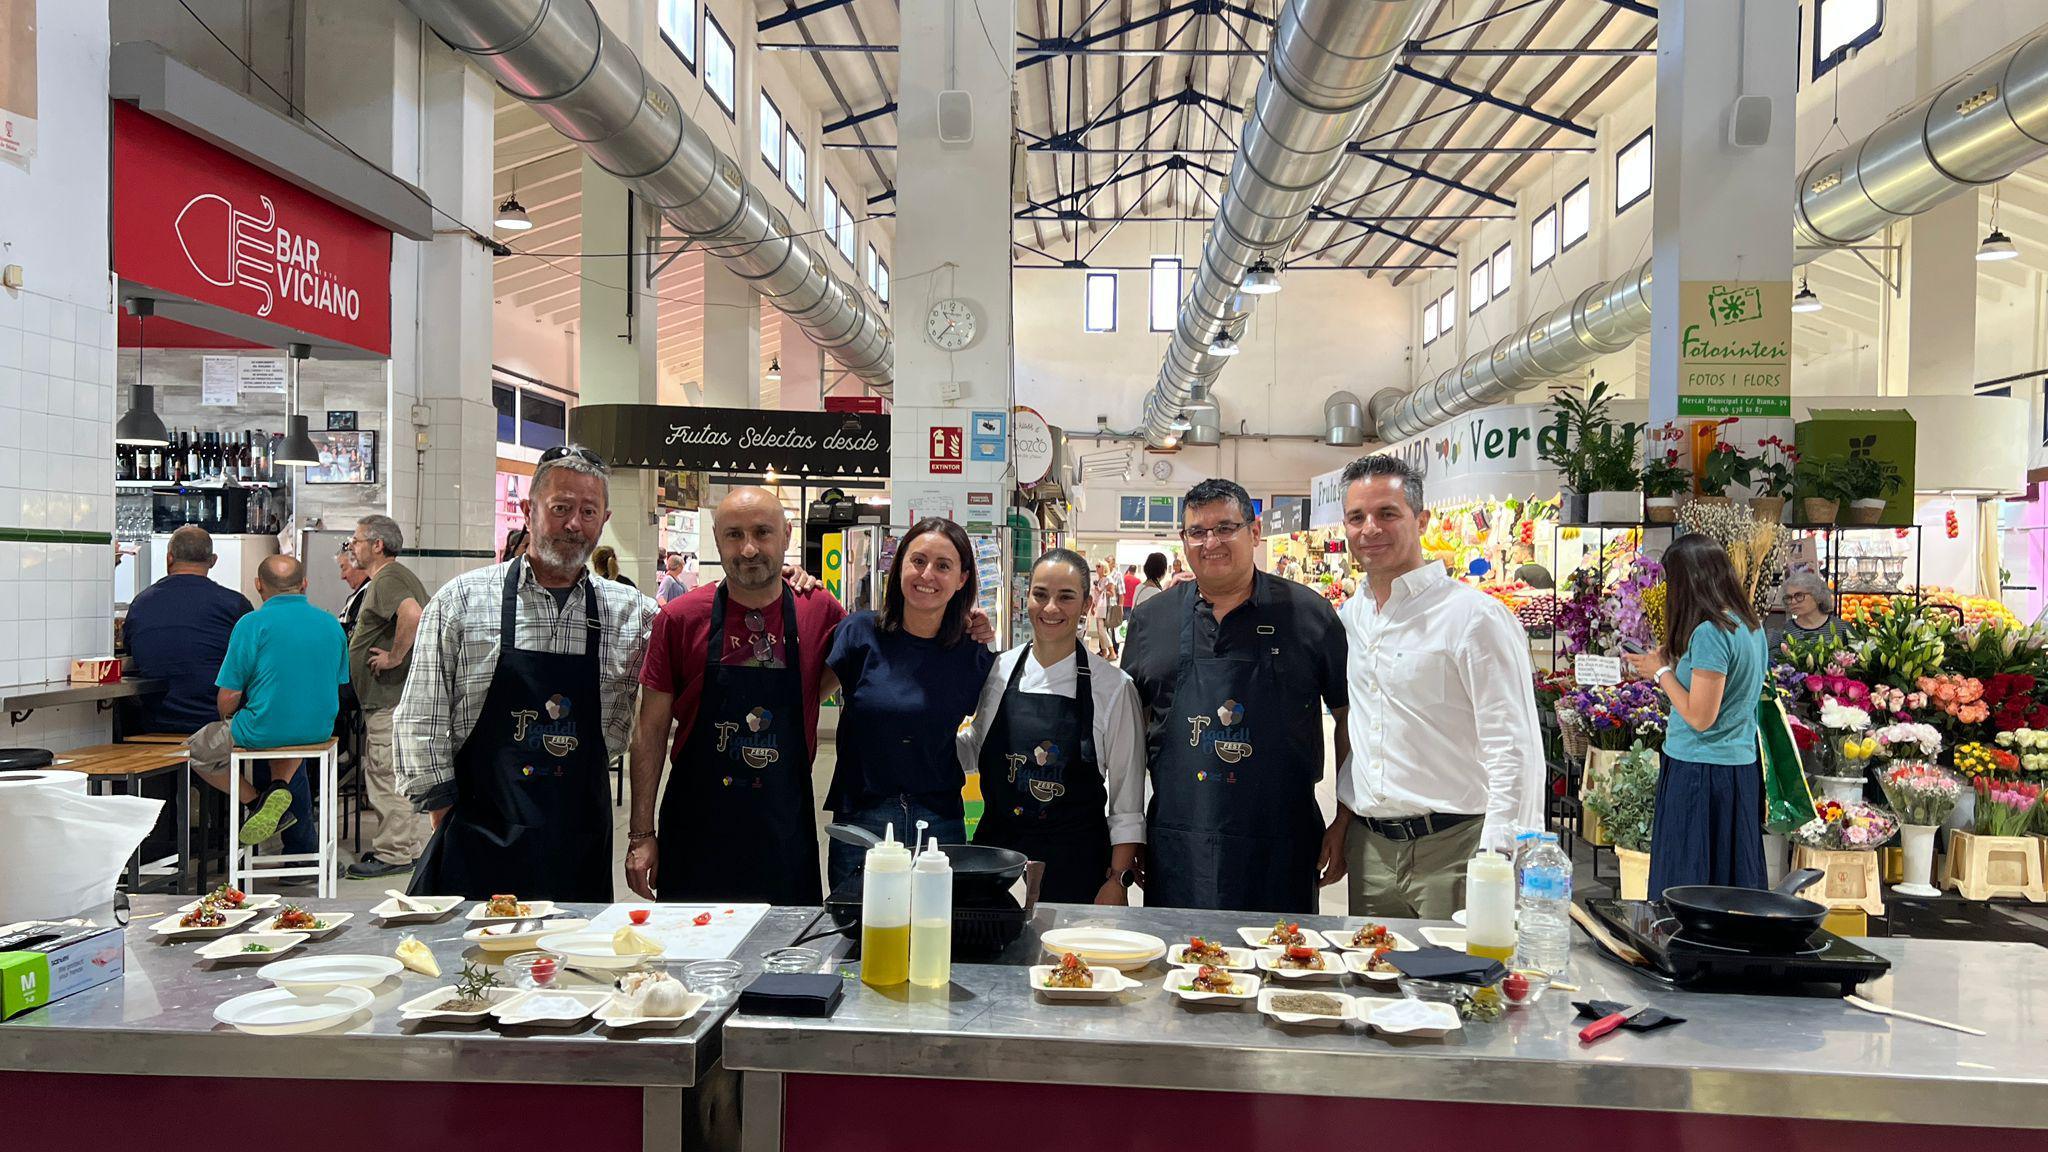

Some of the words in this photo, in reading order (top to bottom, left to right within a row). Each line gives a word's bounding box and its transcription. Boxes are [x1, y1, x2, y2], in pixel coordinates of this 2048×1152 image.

[277, 227, 320, 275] BAR
[277, 262, 360, 321] VICIANO
[1682, 324, 1787, 358] Fotosintesi
[1689, 373, 1725, 387] FOTOS
[1732, 373, 1736, 386] I
[1743, 373, 1781, 387] FLORS
[1707, 398, 1738, 406] Municipal
[665, 424, 731, 445] Frutas
[739, 427, 816, 449] Selectas
[823, 429, 879, 451] desde
[931, 463, 961, 471] EXTINTOR
[20, 971, 36, 992] M
